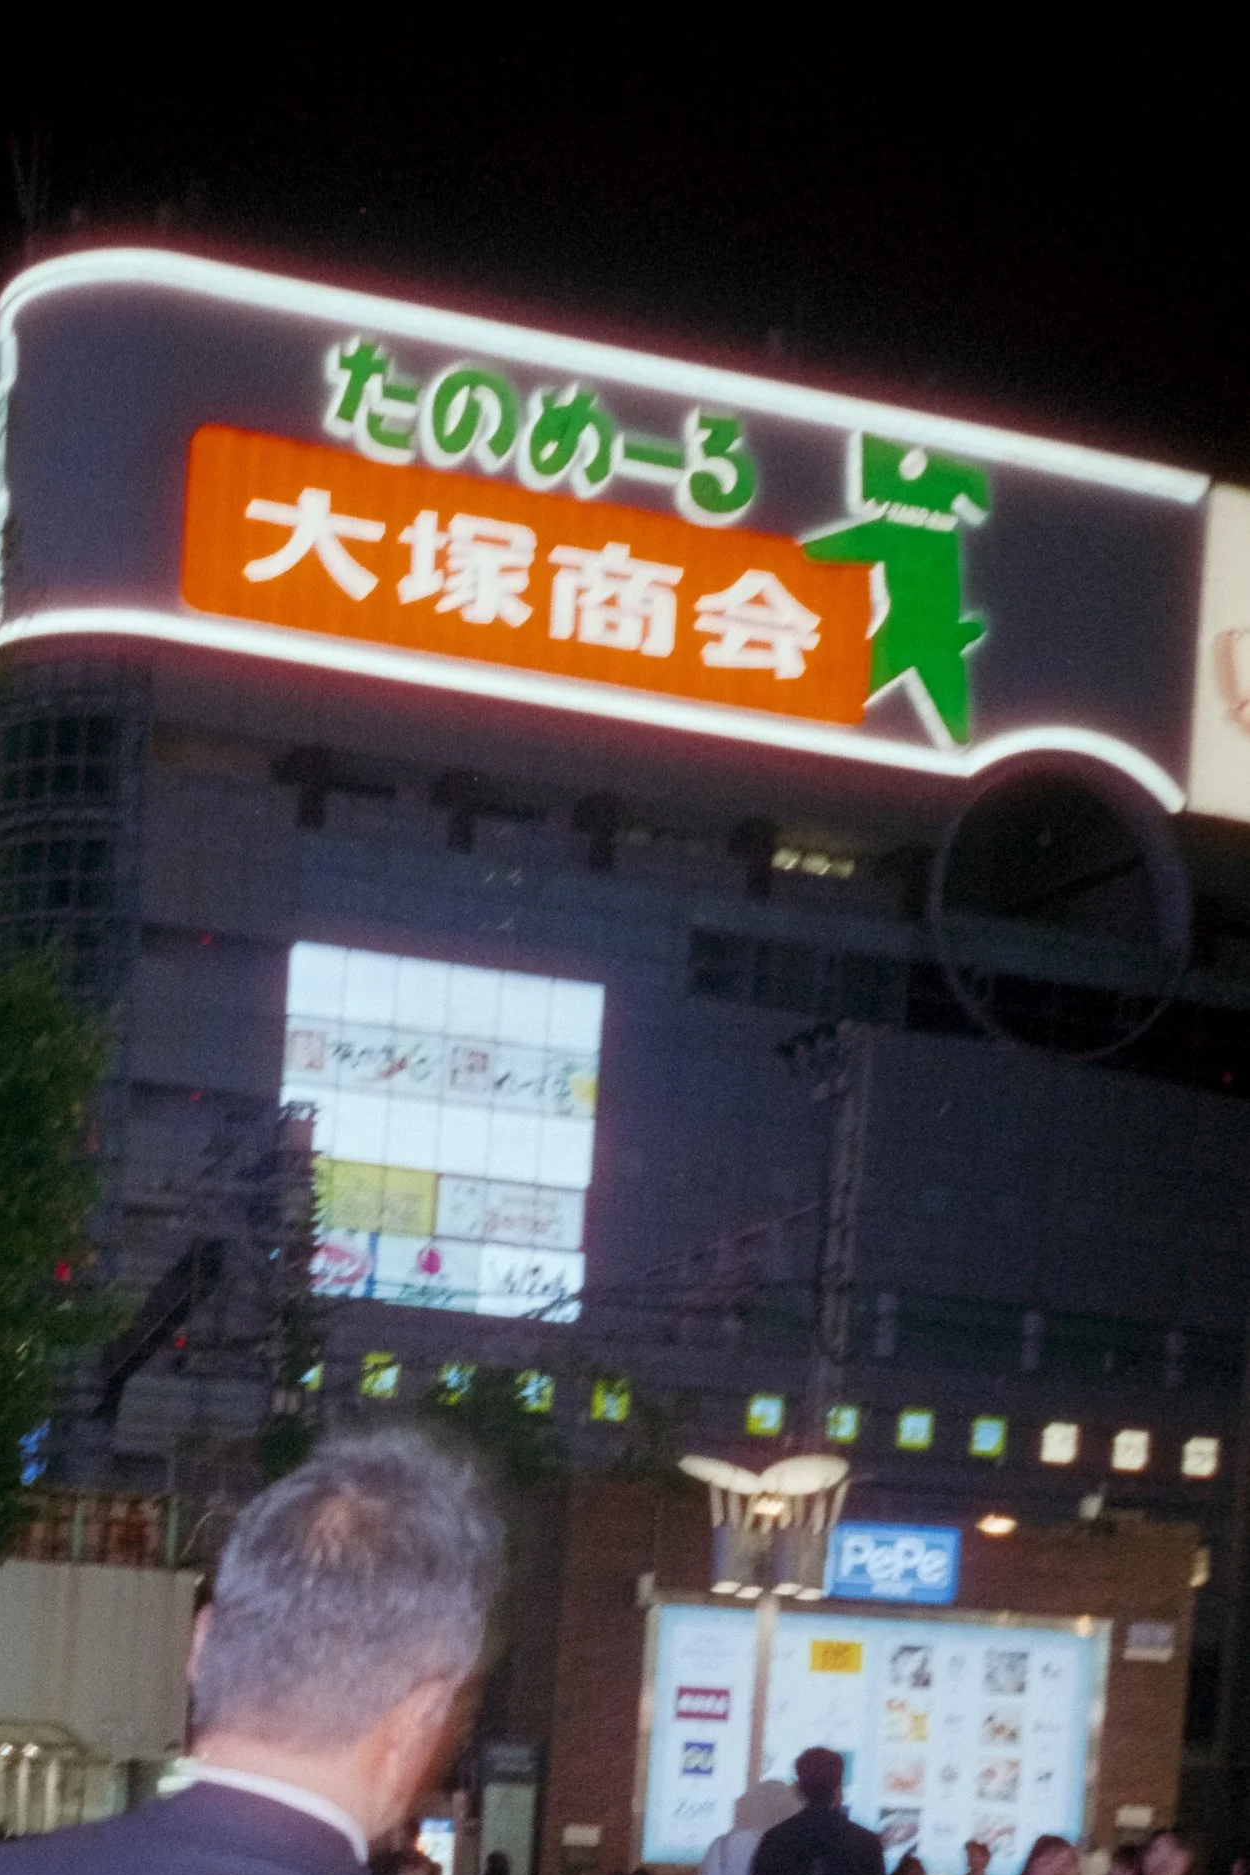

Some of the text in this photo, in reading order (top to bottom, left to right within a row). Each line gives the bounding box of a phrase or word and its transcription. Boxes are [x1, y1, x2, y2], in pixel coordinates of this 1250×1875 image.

[324, 335, 758, 526] たのめーる
[243, 487, 822, 680] 大塚商会
